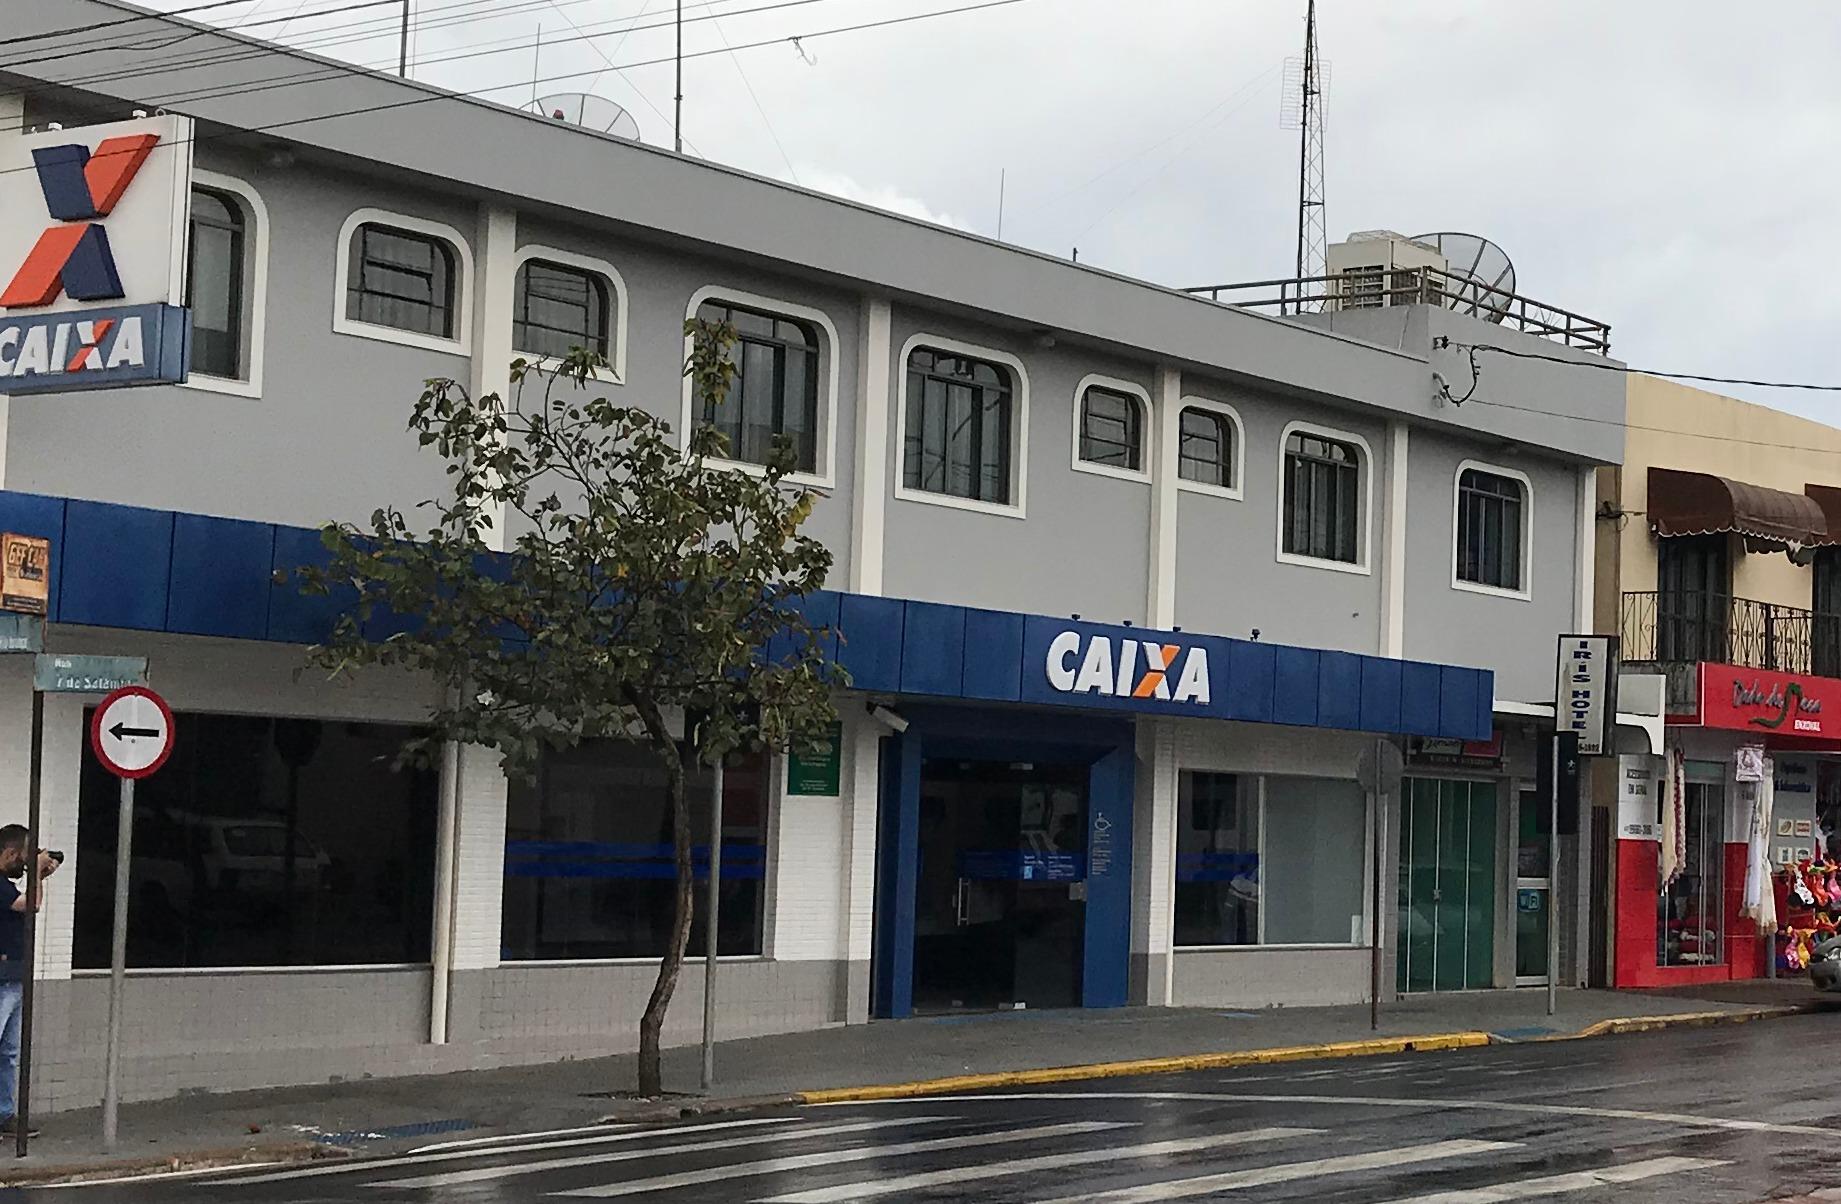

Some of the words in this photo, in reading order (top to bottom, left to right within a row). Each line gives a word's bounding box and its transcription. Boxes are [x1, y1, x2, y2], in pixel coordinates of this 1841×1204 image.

[0, 316, 145, 378] CAIXA
[66, 676, 81, 689] de
[1046, 631, 1211, 705] CAIXA
[1572, 640, 1592, 683] IRIS
